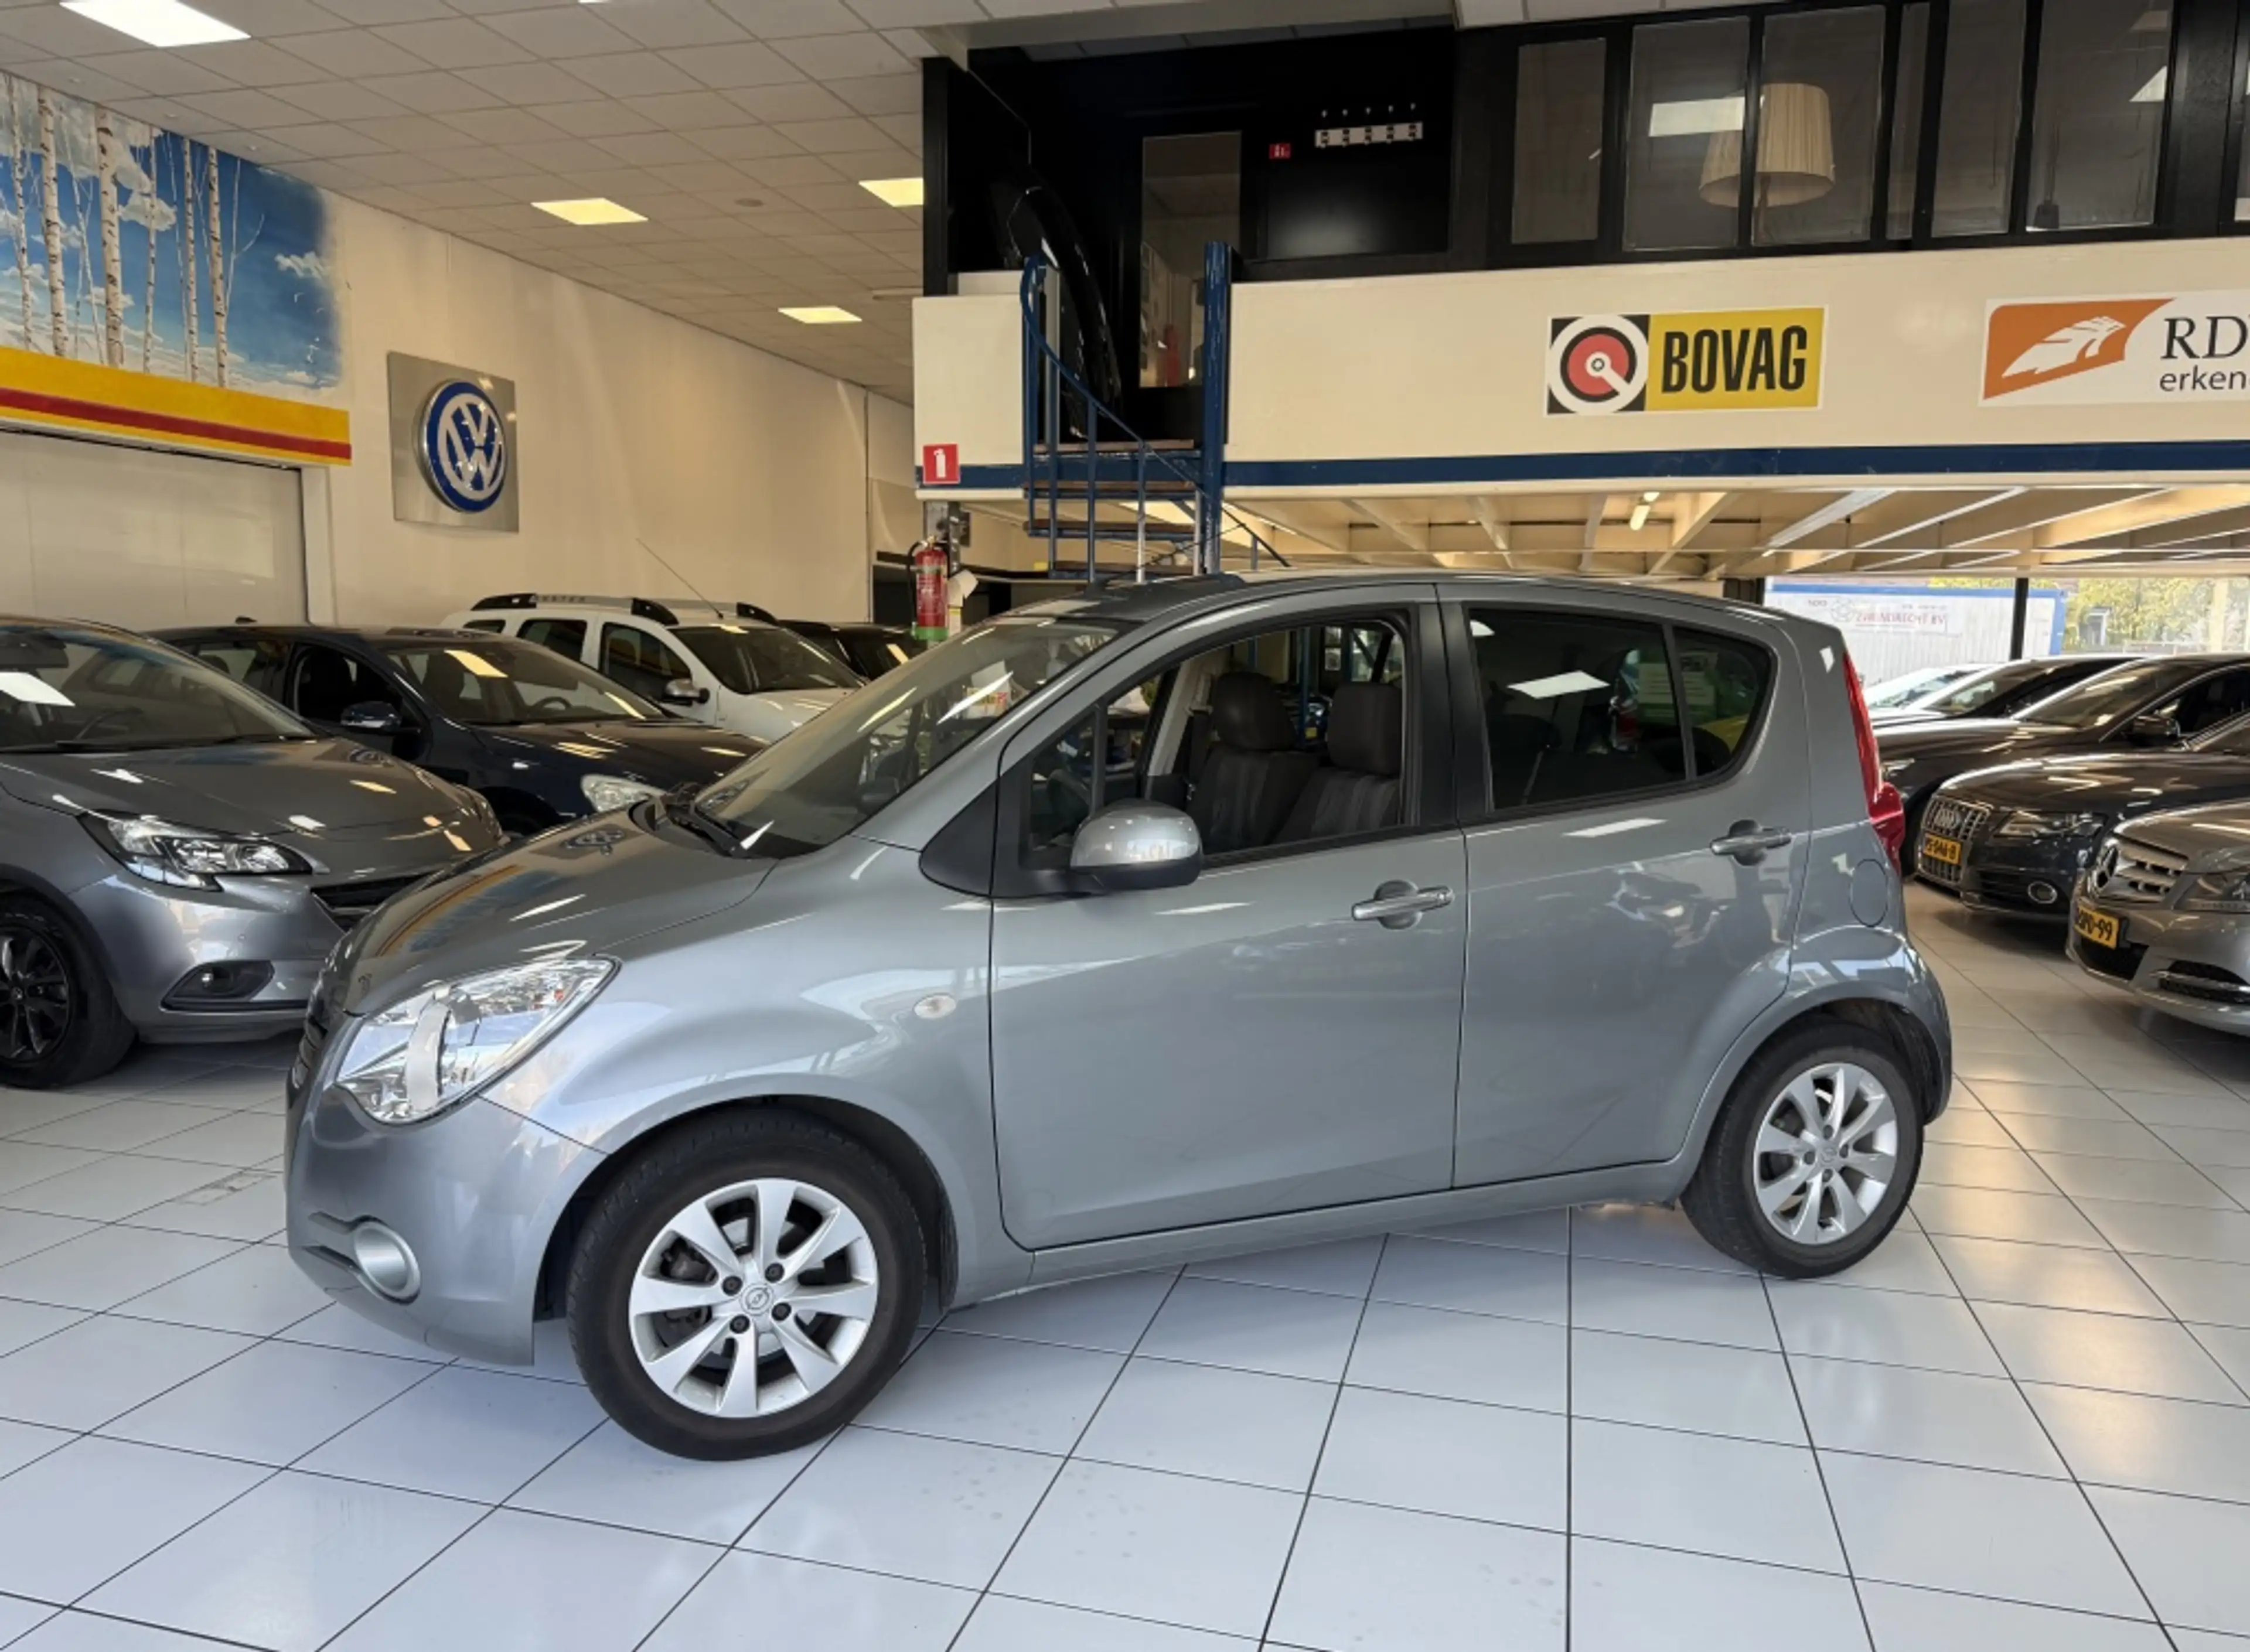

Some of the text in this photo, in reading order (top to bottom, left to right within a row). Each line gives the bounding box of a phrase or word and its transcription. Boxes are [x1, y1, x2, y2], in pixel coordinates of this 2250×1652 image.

[1662, 325, 1807, 393] BOVAG
[2160, 316, 2250, 359] RD
[2159, 364, 2250, 392] erken
